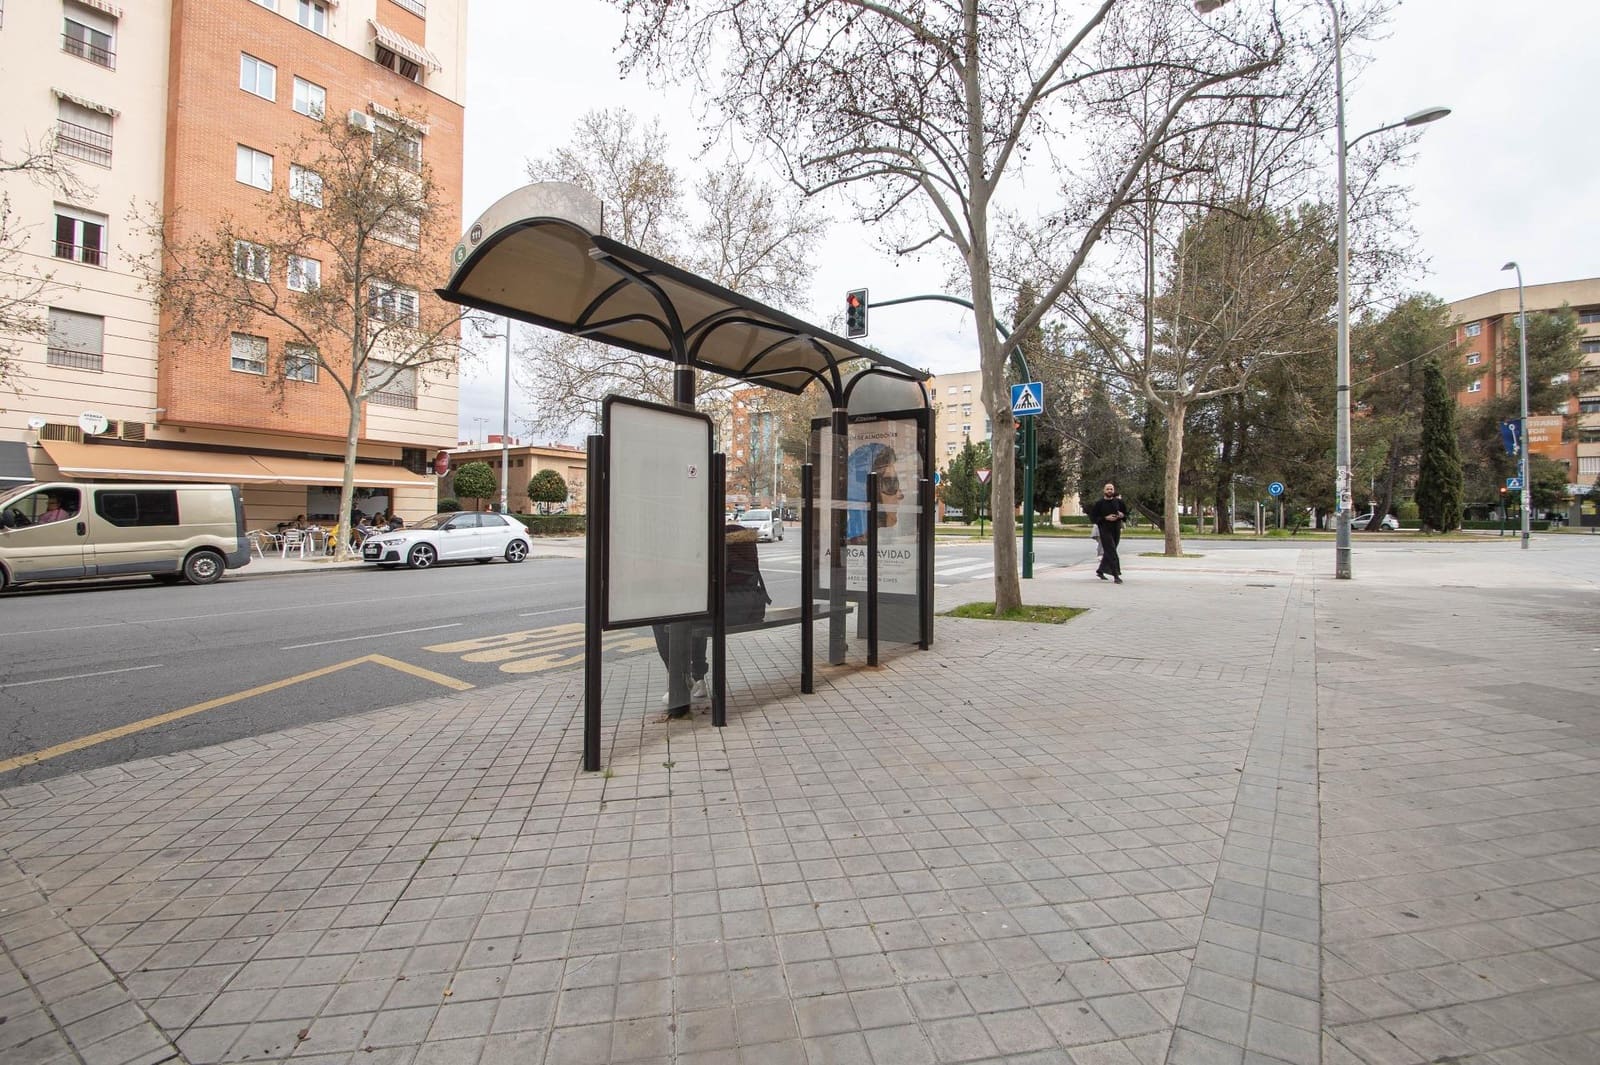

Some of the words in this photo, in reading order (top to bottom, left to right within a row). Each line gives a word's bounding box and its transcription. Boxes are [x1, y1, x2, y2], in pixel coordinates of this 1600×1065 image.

[824, 548, 866, 558] ARGA
[876, 549, 911, 559] AVIDAD
[421, 622, 659, 674] BUS
